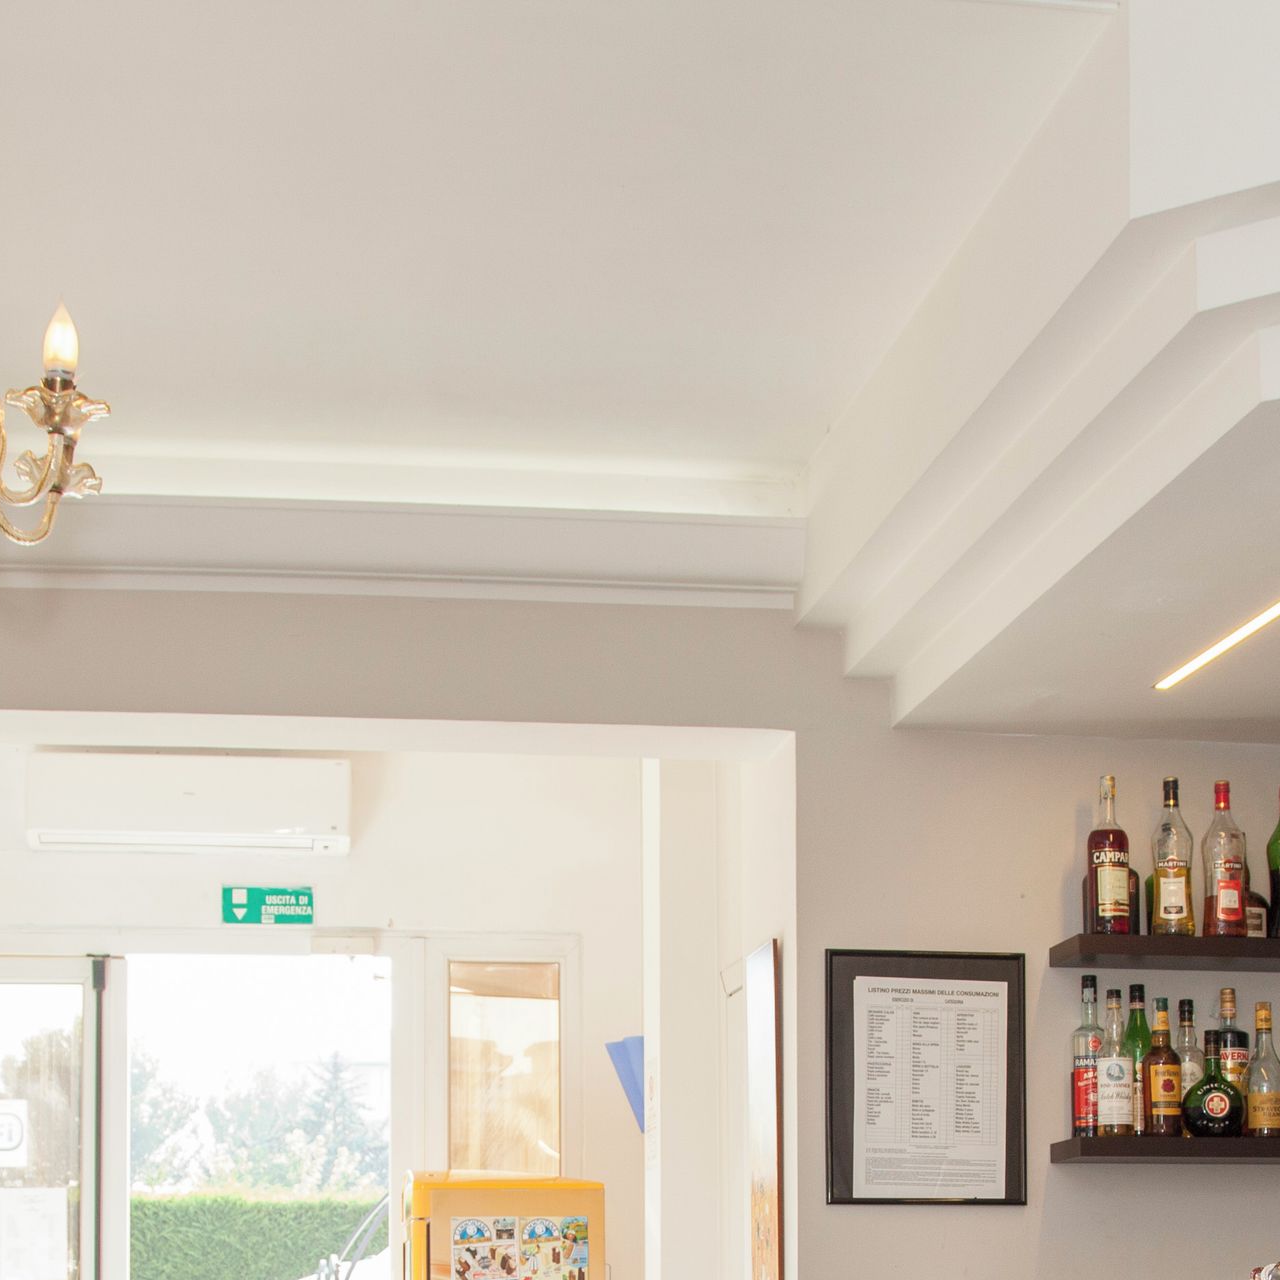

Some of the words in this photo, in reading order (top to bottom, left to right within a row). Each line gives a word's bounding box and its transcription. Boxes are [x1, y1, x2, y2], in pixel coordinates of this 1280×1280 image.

[265, 895, 296, 905] USCITA
[299, 895, 308, 905] DI
[261, 905, 312, 915] EMERGENZA
[1197, 1083, 1234, 1096] UNICUM
